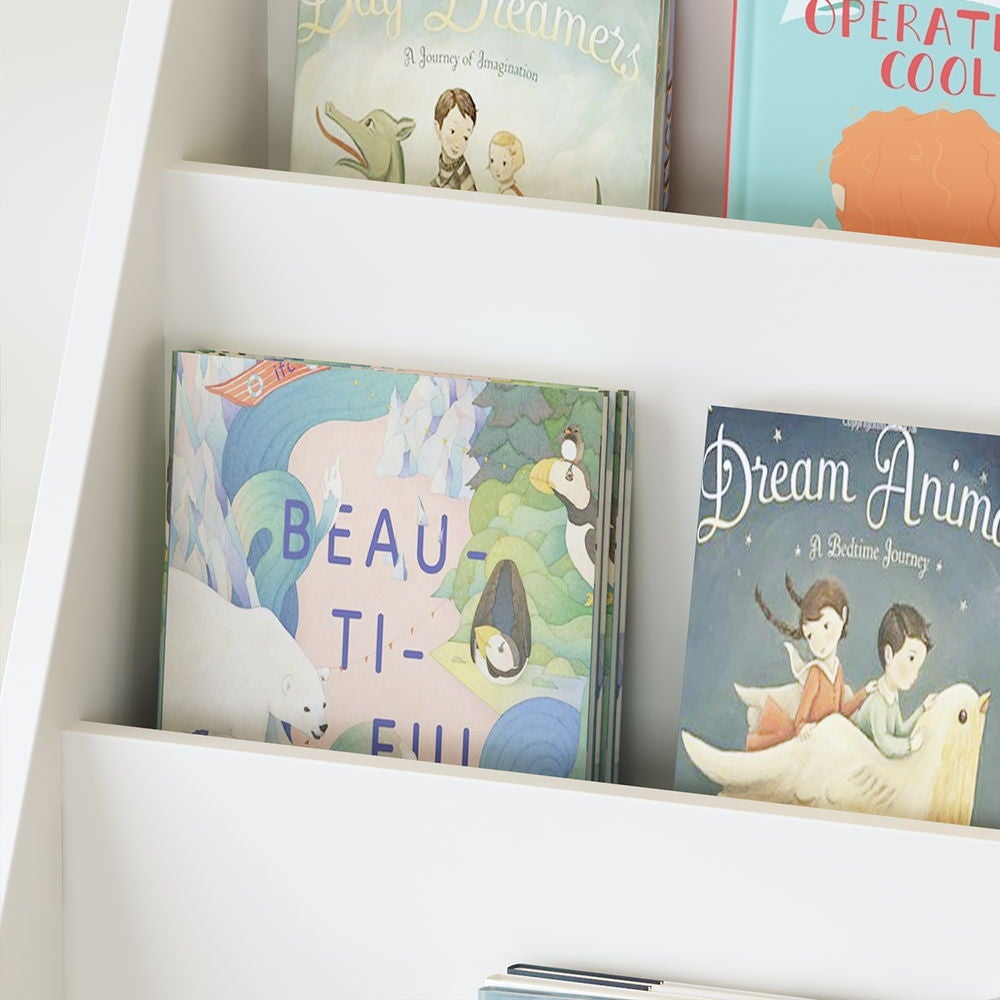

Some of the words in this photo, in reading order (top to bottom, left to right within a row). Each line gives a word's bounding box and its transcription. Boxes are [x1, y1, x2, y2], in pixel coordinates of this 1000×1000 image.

[403, 46, 416, 67] A
[418, 45, 460, 72] Journey
[462, 50, 475, 66] of
[477, 49, 539, 83] Imagination
[880, 50, 997, 98] COOL
[697, 423, 857, 545] Dream
[809, 534, 823, 561] A
[827, 532, 880, 561] Bedtime
[882, 536, 930, 580] Journey
[331, 608, 424, 674] TI-
